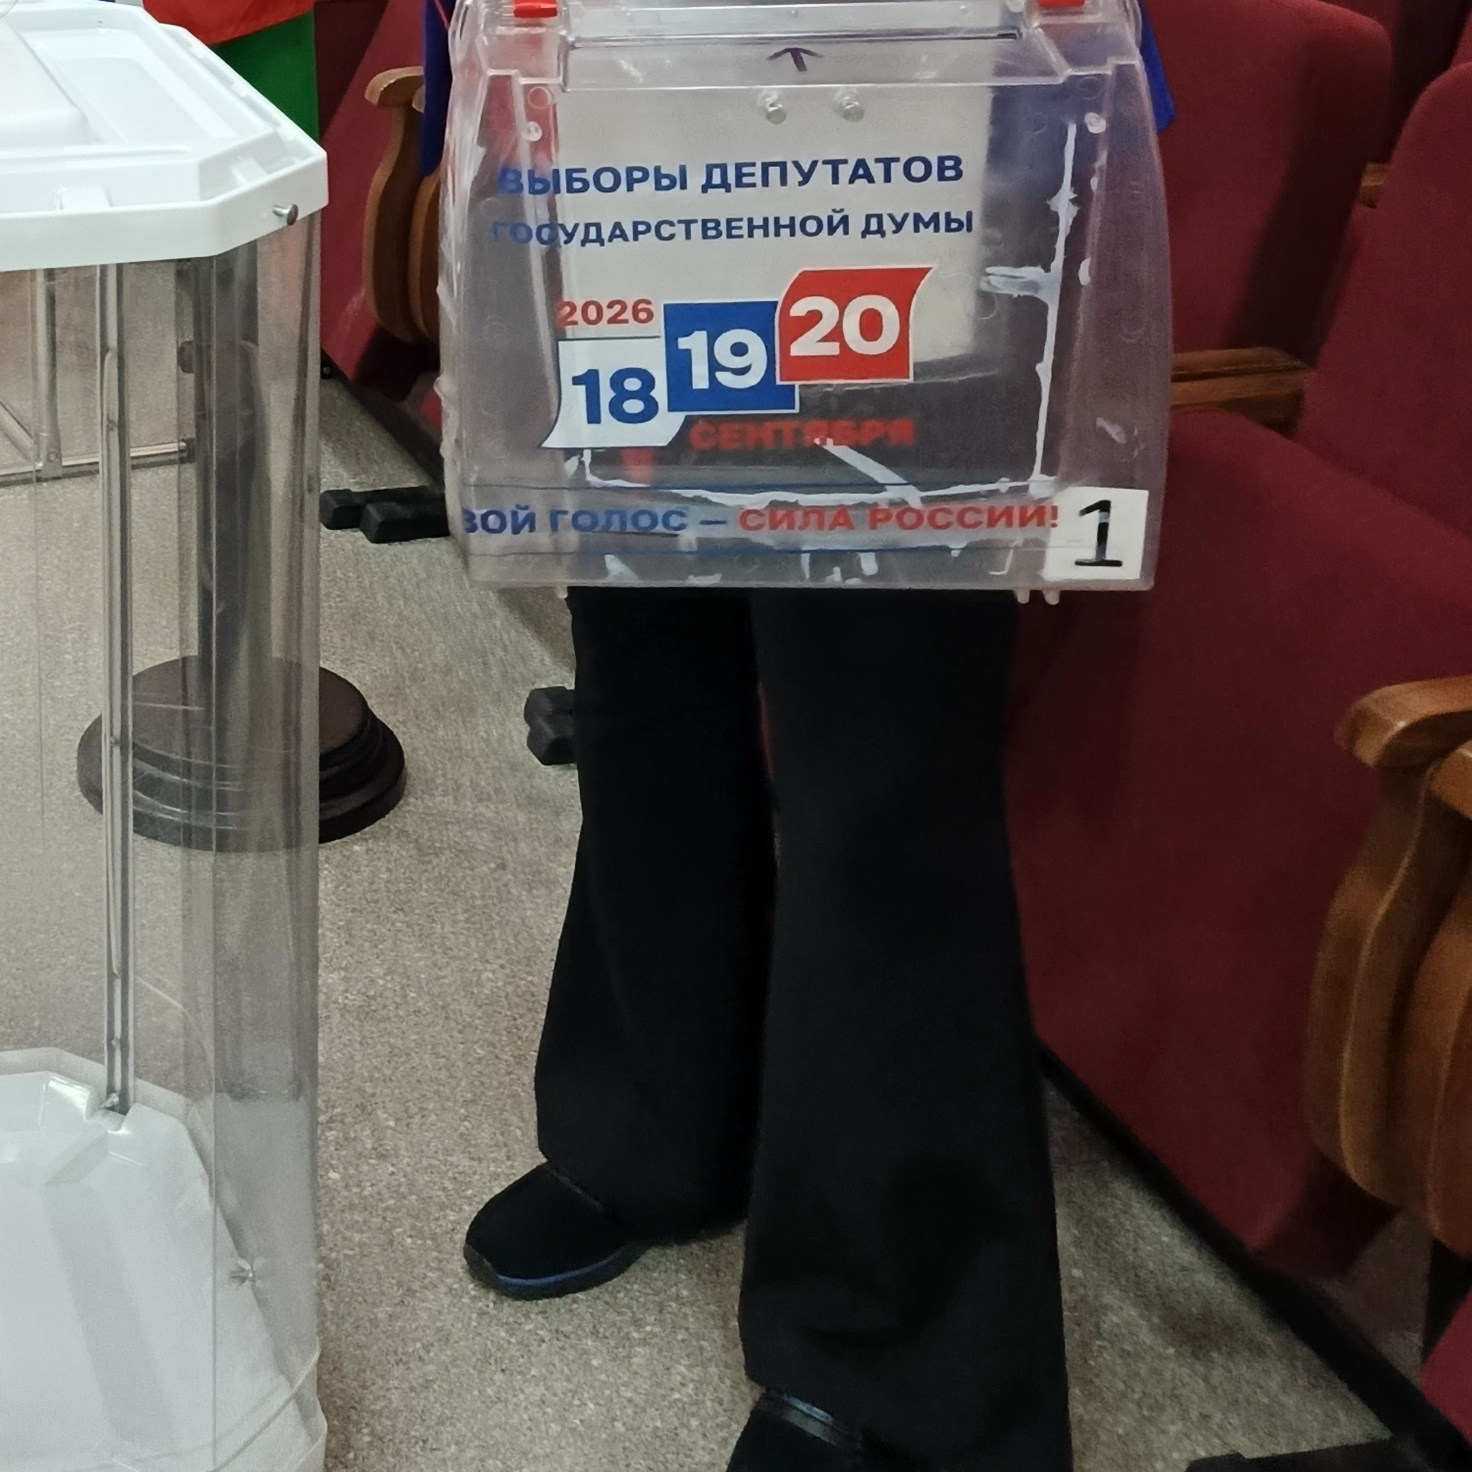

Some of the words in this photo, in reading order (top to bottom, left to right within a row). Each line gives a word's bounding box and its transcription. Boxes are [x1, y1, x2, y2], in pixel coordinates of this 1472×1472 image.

[499, 163, 688, 195] ВЫБОРЫ
[701, 154, 964, 193] ДЕПУТАТОВ
[492, 208, 850, 248] ГОСУДАРСТВЕННОЙ
[860, 210, 974, 239] ДУМЫ
[556, 298, 655, 327] 2026
[789, 294, 900, 356] 20
[677, 328, 768, 390] 19
[571, 367, 659, 425] 18
[549, 506, 688, 534] ГОЛОС
[739, 505, 856, 532] СИЛА
[868, 504, 1060, 531] РОССИИ!
[1074, 499, 1124, 568] 1
